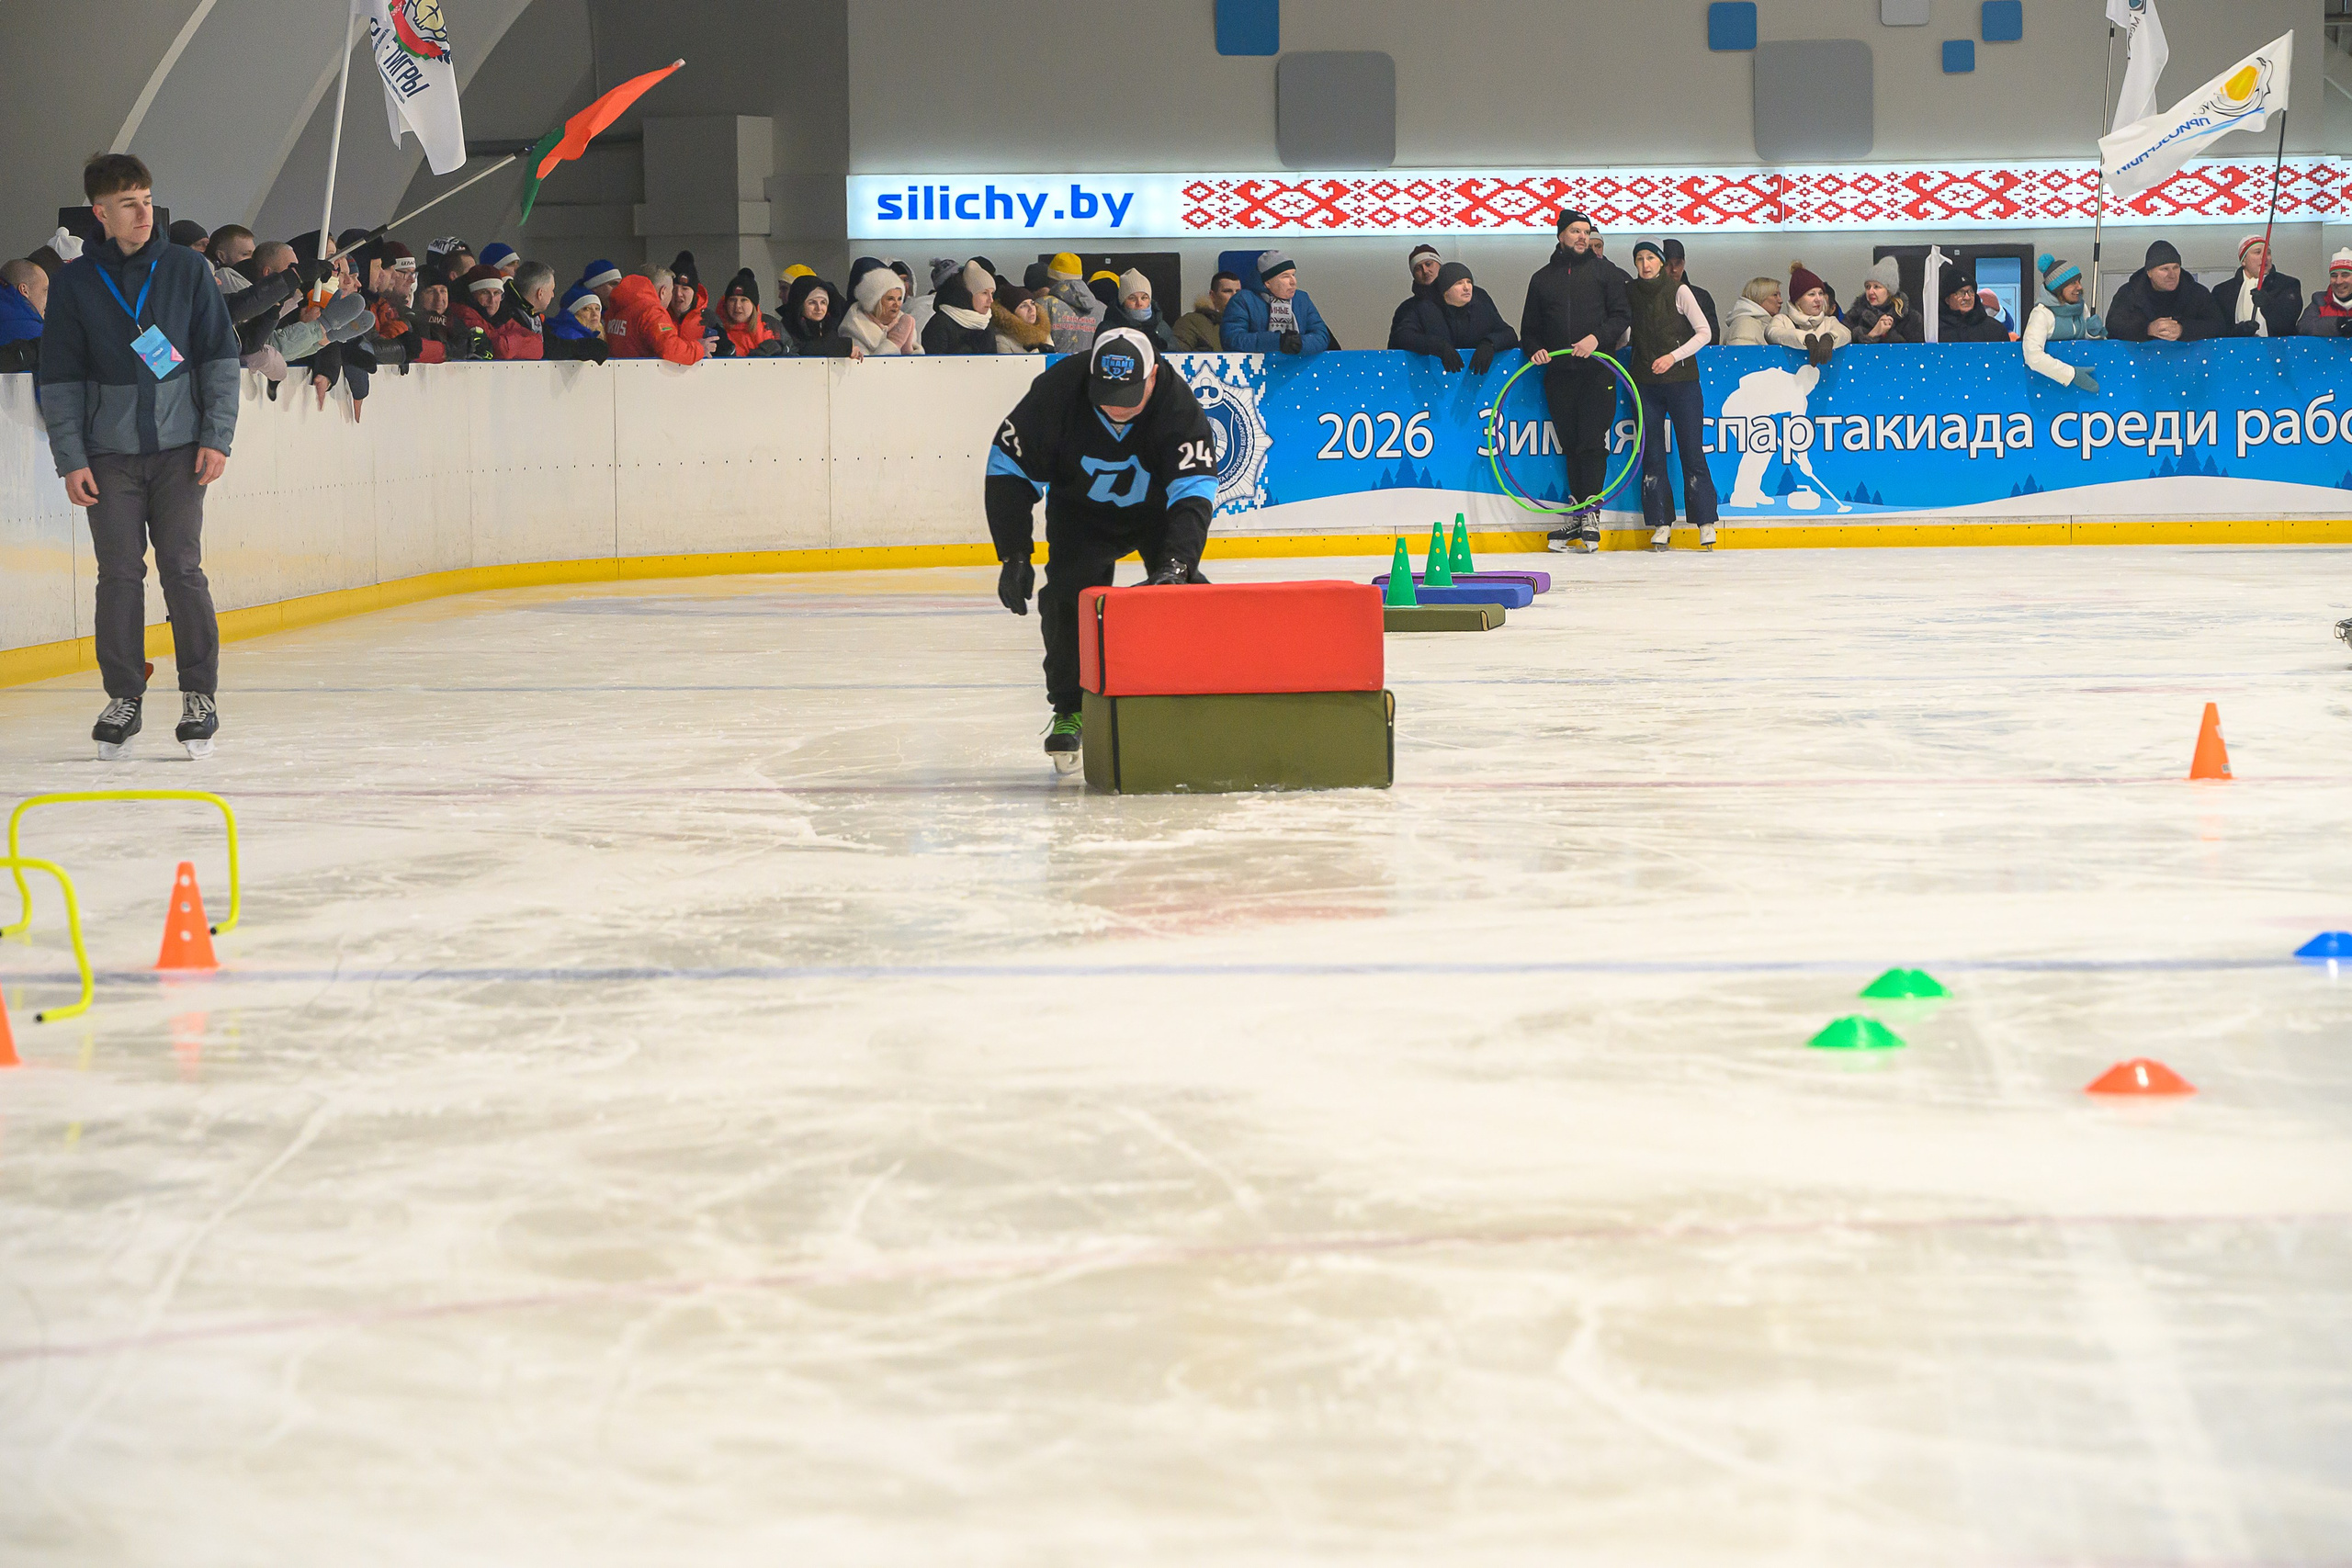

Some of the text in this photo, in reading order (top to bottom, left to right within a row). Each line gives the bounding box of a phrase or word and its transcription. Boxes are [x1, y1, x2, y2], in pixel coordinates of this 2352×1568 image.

[877, 185, 1135, 228] silichy.by
[1178, 440, 1213, 470] 24
[1317, 410, 1435, 460] 2026
[2050, 410, 2218, 460] среди
